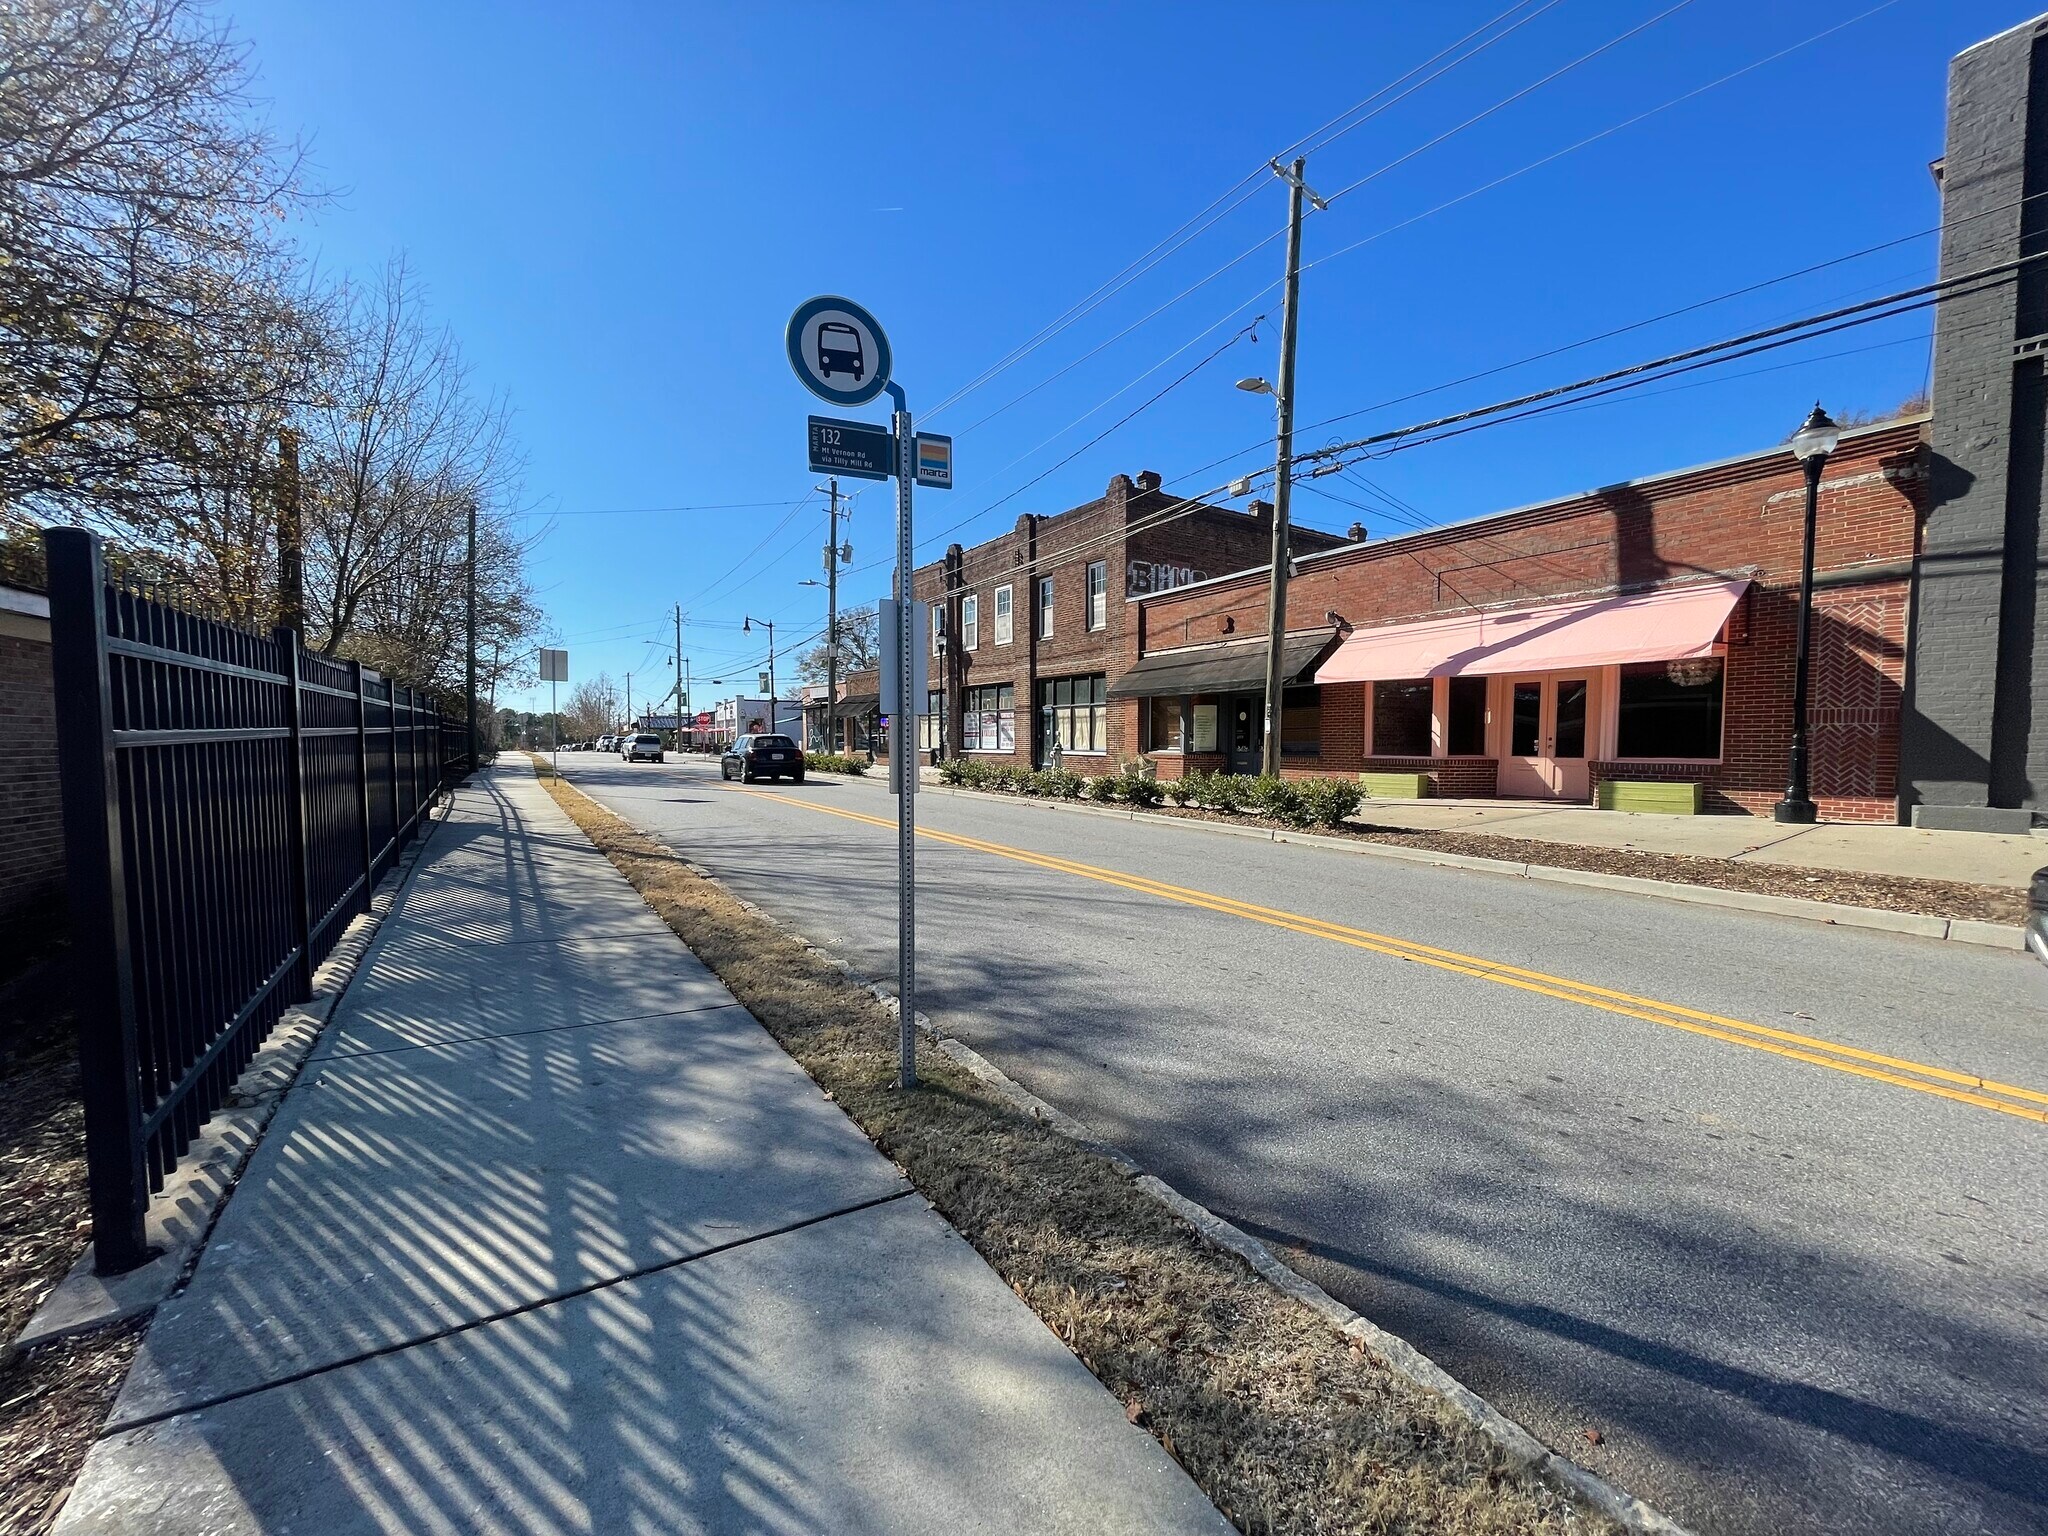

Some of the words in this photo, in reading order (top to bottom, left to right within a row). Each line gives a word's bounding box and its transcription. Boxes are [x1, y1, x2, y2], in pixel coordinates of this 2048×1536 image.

[821, 428, 841, 445] 132
[821, 446, 830, 454] Mt
[831, 448, 856, 458] Vernon
[857, 451, 866, 459] Rd
[834, 457, 849, 467] Tilly
[850, 459, 863, 467] Mill
[920, 467, 948, 479] marta
